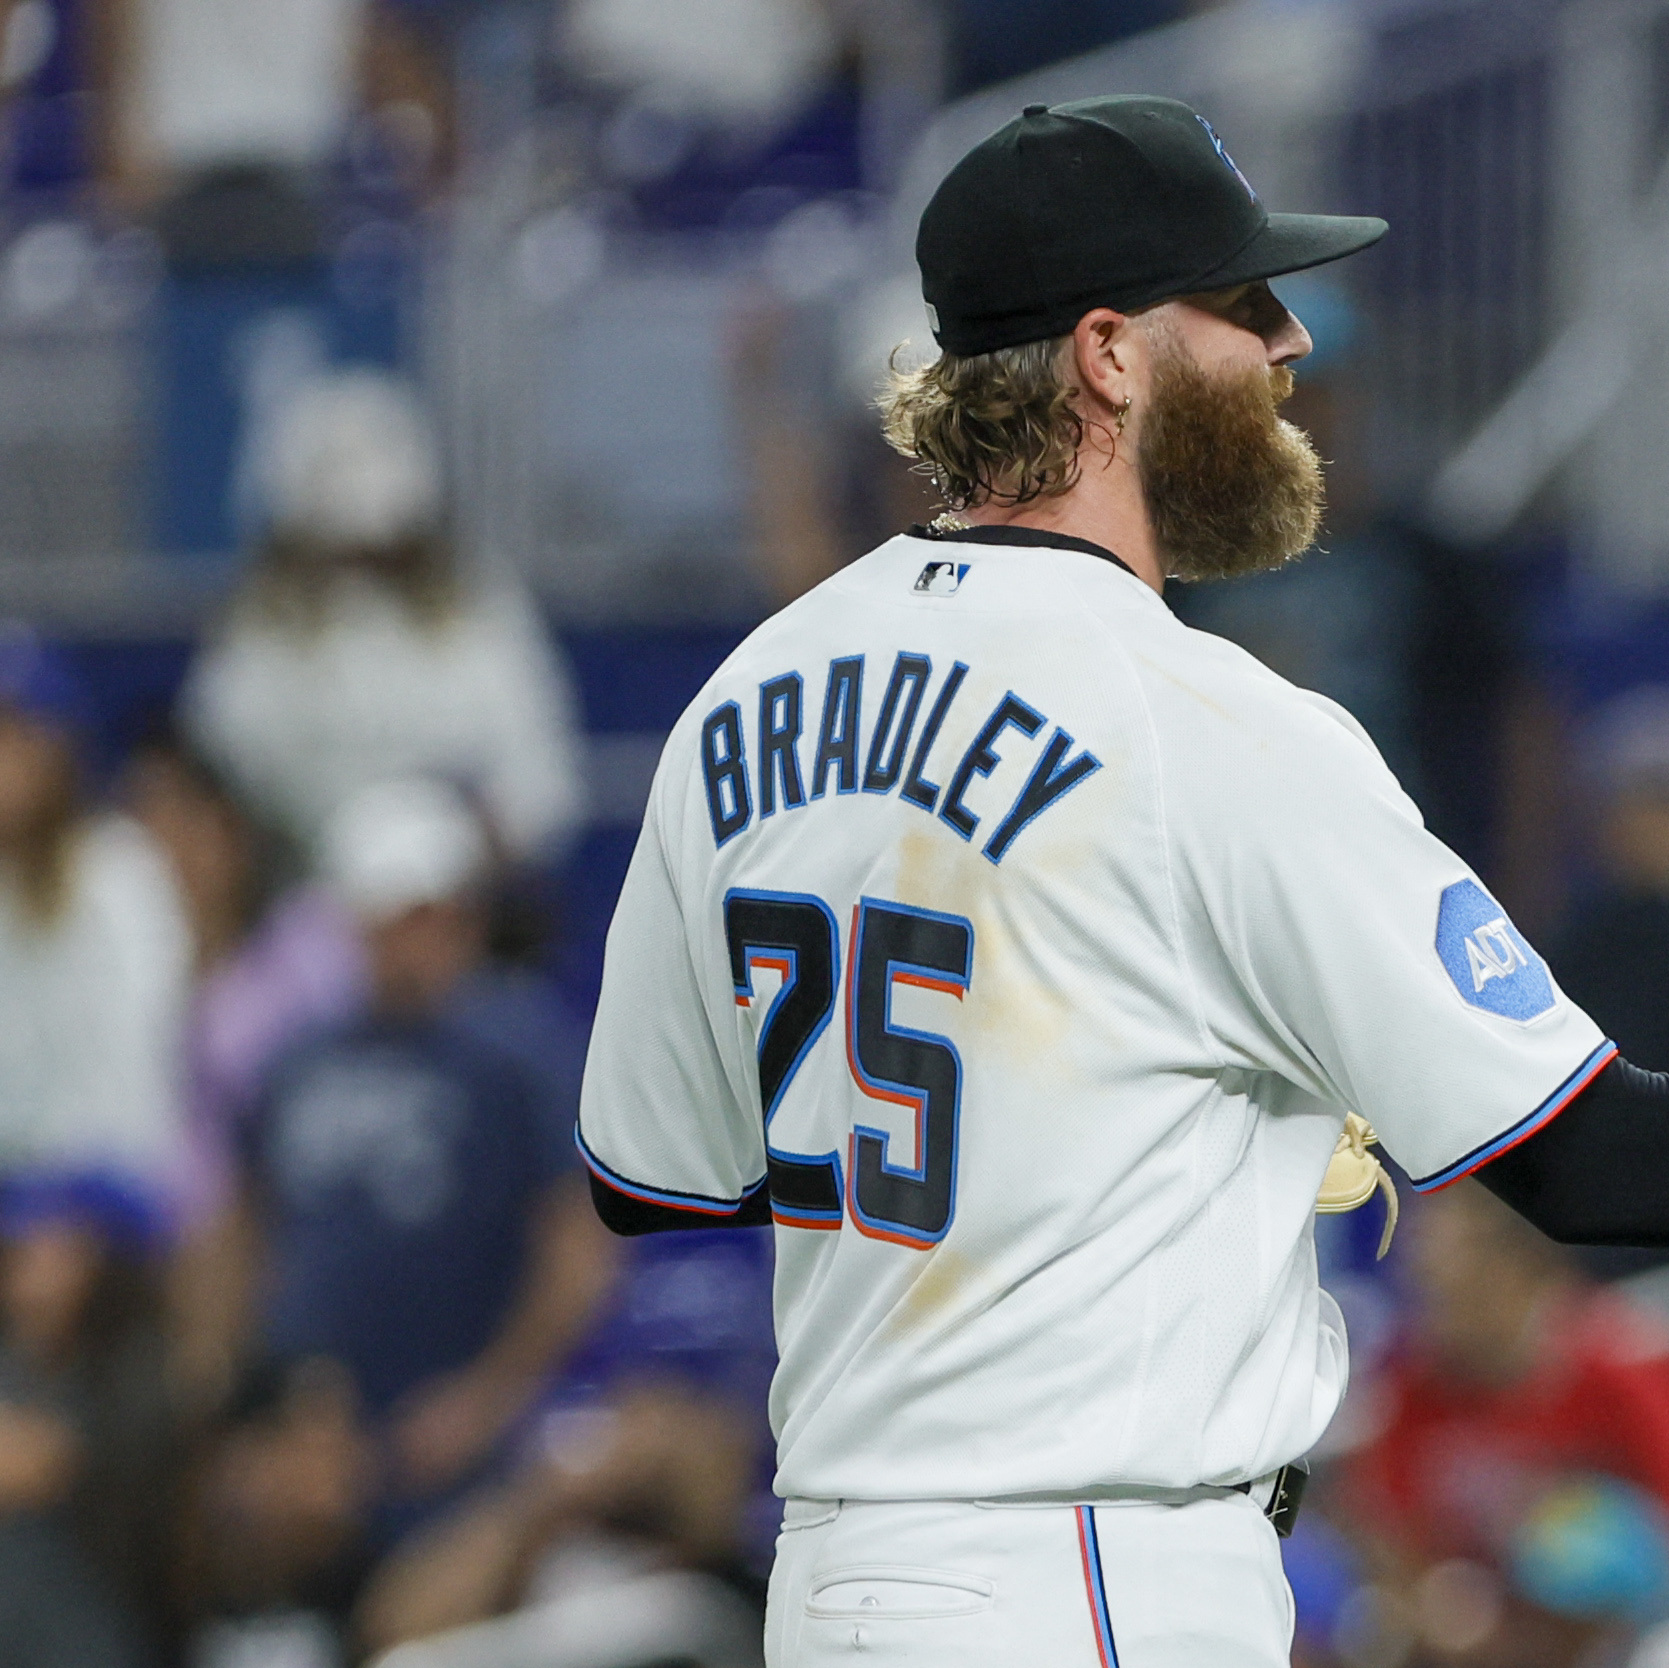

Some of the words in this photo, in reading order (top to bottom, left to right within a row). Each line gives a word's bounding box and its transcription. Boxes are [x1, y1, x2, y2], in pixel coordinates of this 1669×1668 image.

[700, 650, 1104, 866] BRADLEY
[1464, 916, 1529, 993] ADT
[723, 886, 975, 1251] 25
